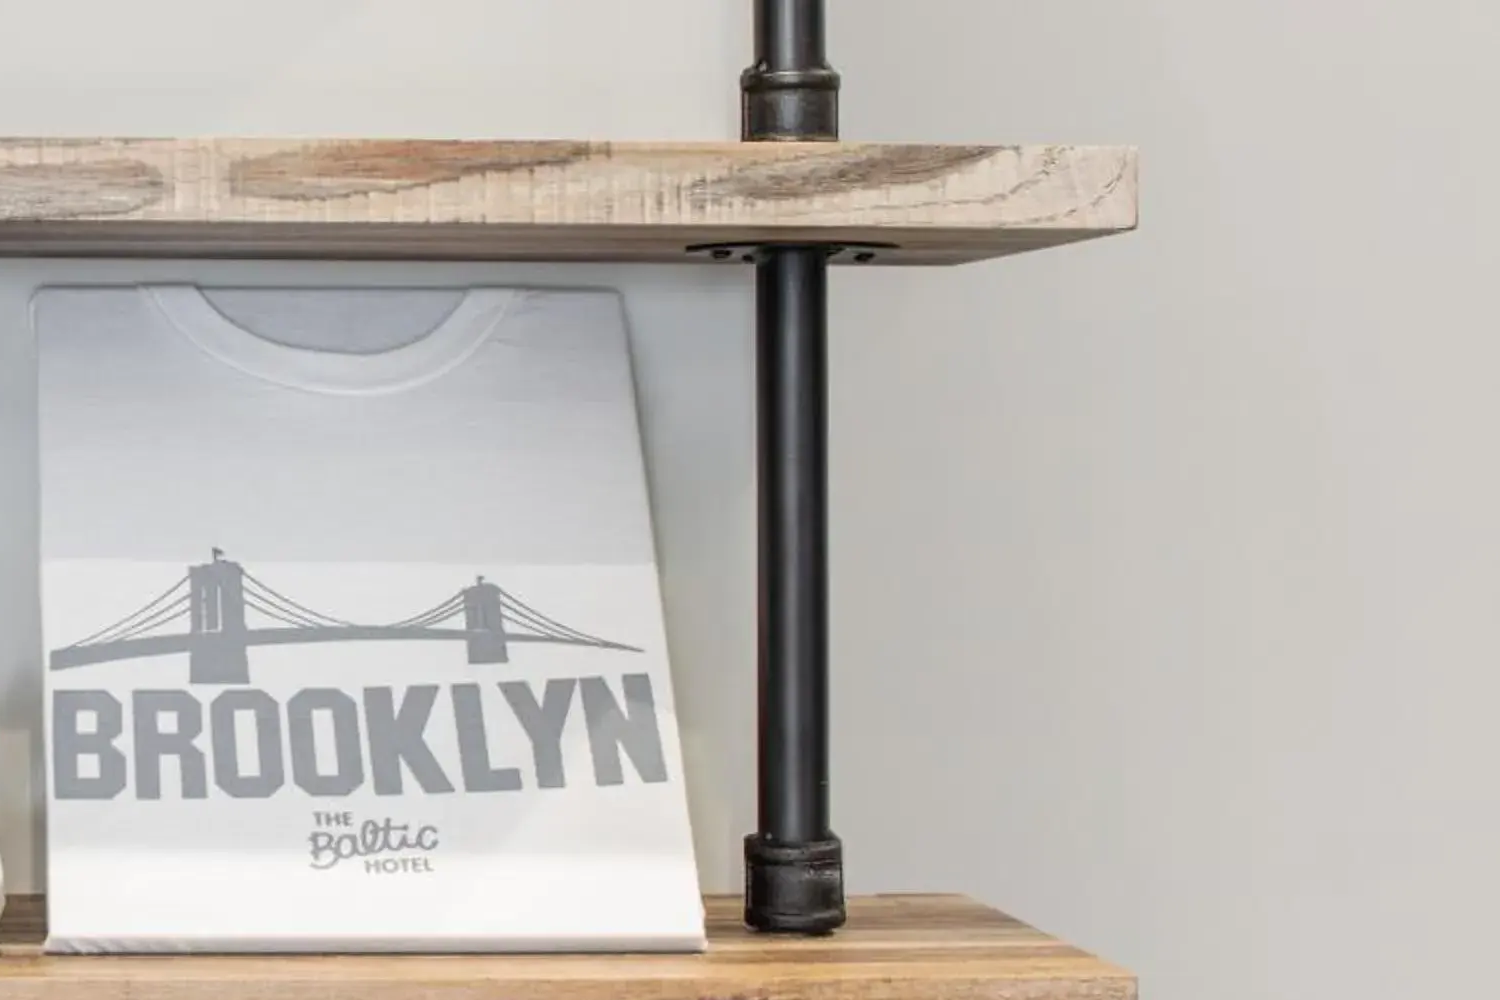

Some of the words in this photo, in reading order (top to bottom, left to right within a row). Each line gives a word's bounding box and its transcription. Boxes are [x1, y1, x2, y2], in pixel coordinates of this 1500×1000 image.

[52, 673, 668, 800] BROOKLYN
[312, 811, 353, 827] THE
[309, 817, 439, 868] Baltic
[364, 856, 434, 875] HOTEL
